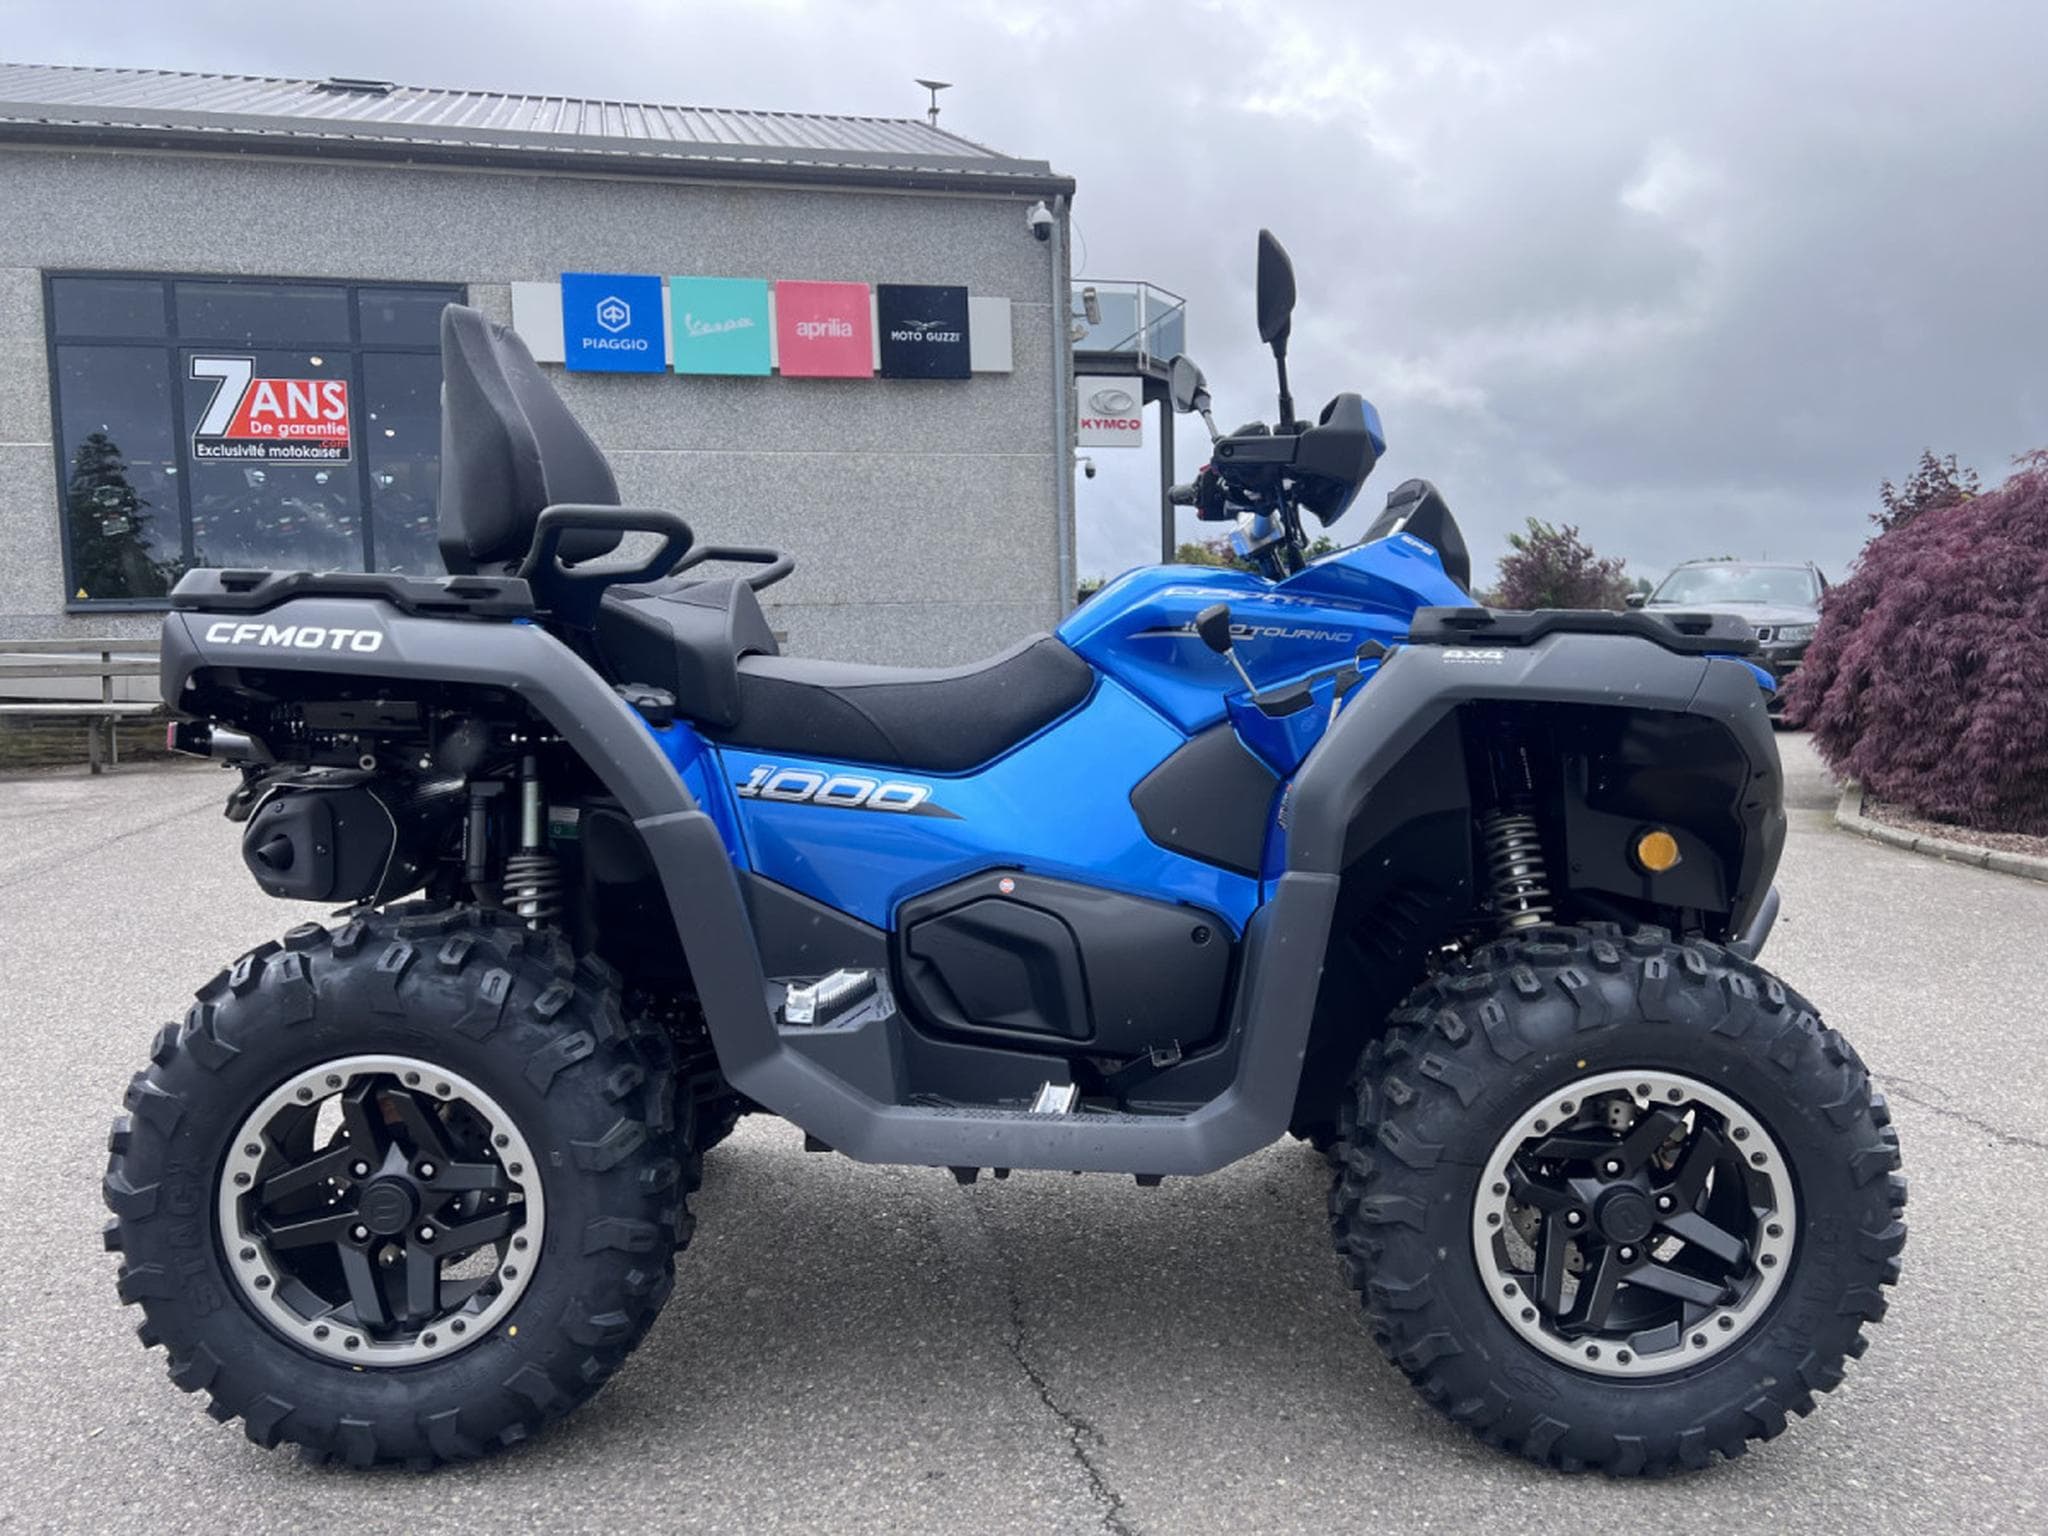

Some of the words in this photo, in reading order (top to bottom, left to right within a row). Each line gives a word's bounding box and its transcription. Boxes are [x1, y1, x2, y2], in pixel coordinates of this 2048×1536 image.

[796, 318, 852, 340] aprilia
[891, 331, 922, 341] MOTO
[926, 332, 961, 342] GUZZI
[582, 338, 648, 351] PIAGGIO
[191, 357, 254, 437] 7
[250, 381, 346, 420] ANS
[250, 421, 274, 435] De
[278, 423, 347, 438] garantie
[1080, 418, 1141, 430] KYMCO
[197, 443, 266, 457] Exclusivité
[206, 622, 383, 652] CFMOTO
[1250, 626, 1353, 643] TOURING
[736, 764, 932, 812] 1000
